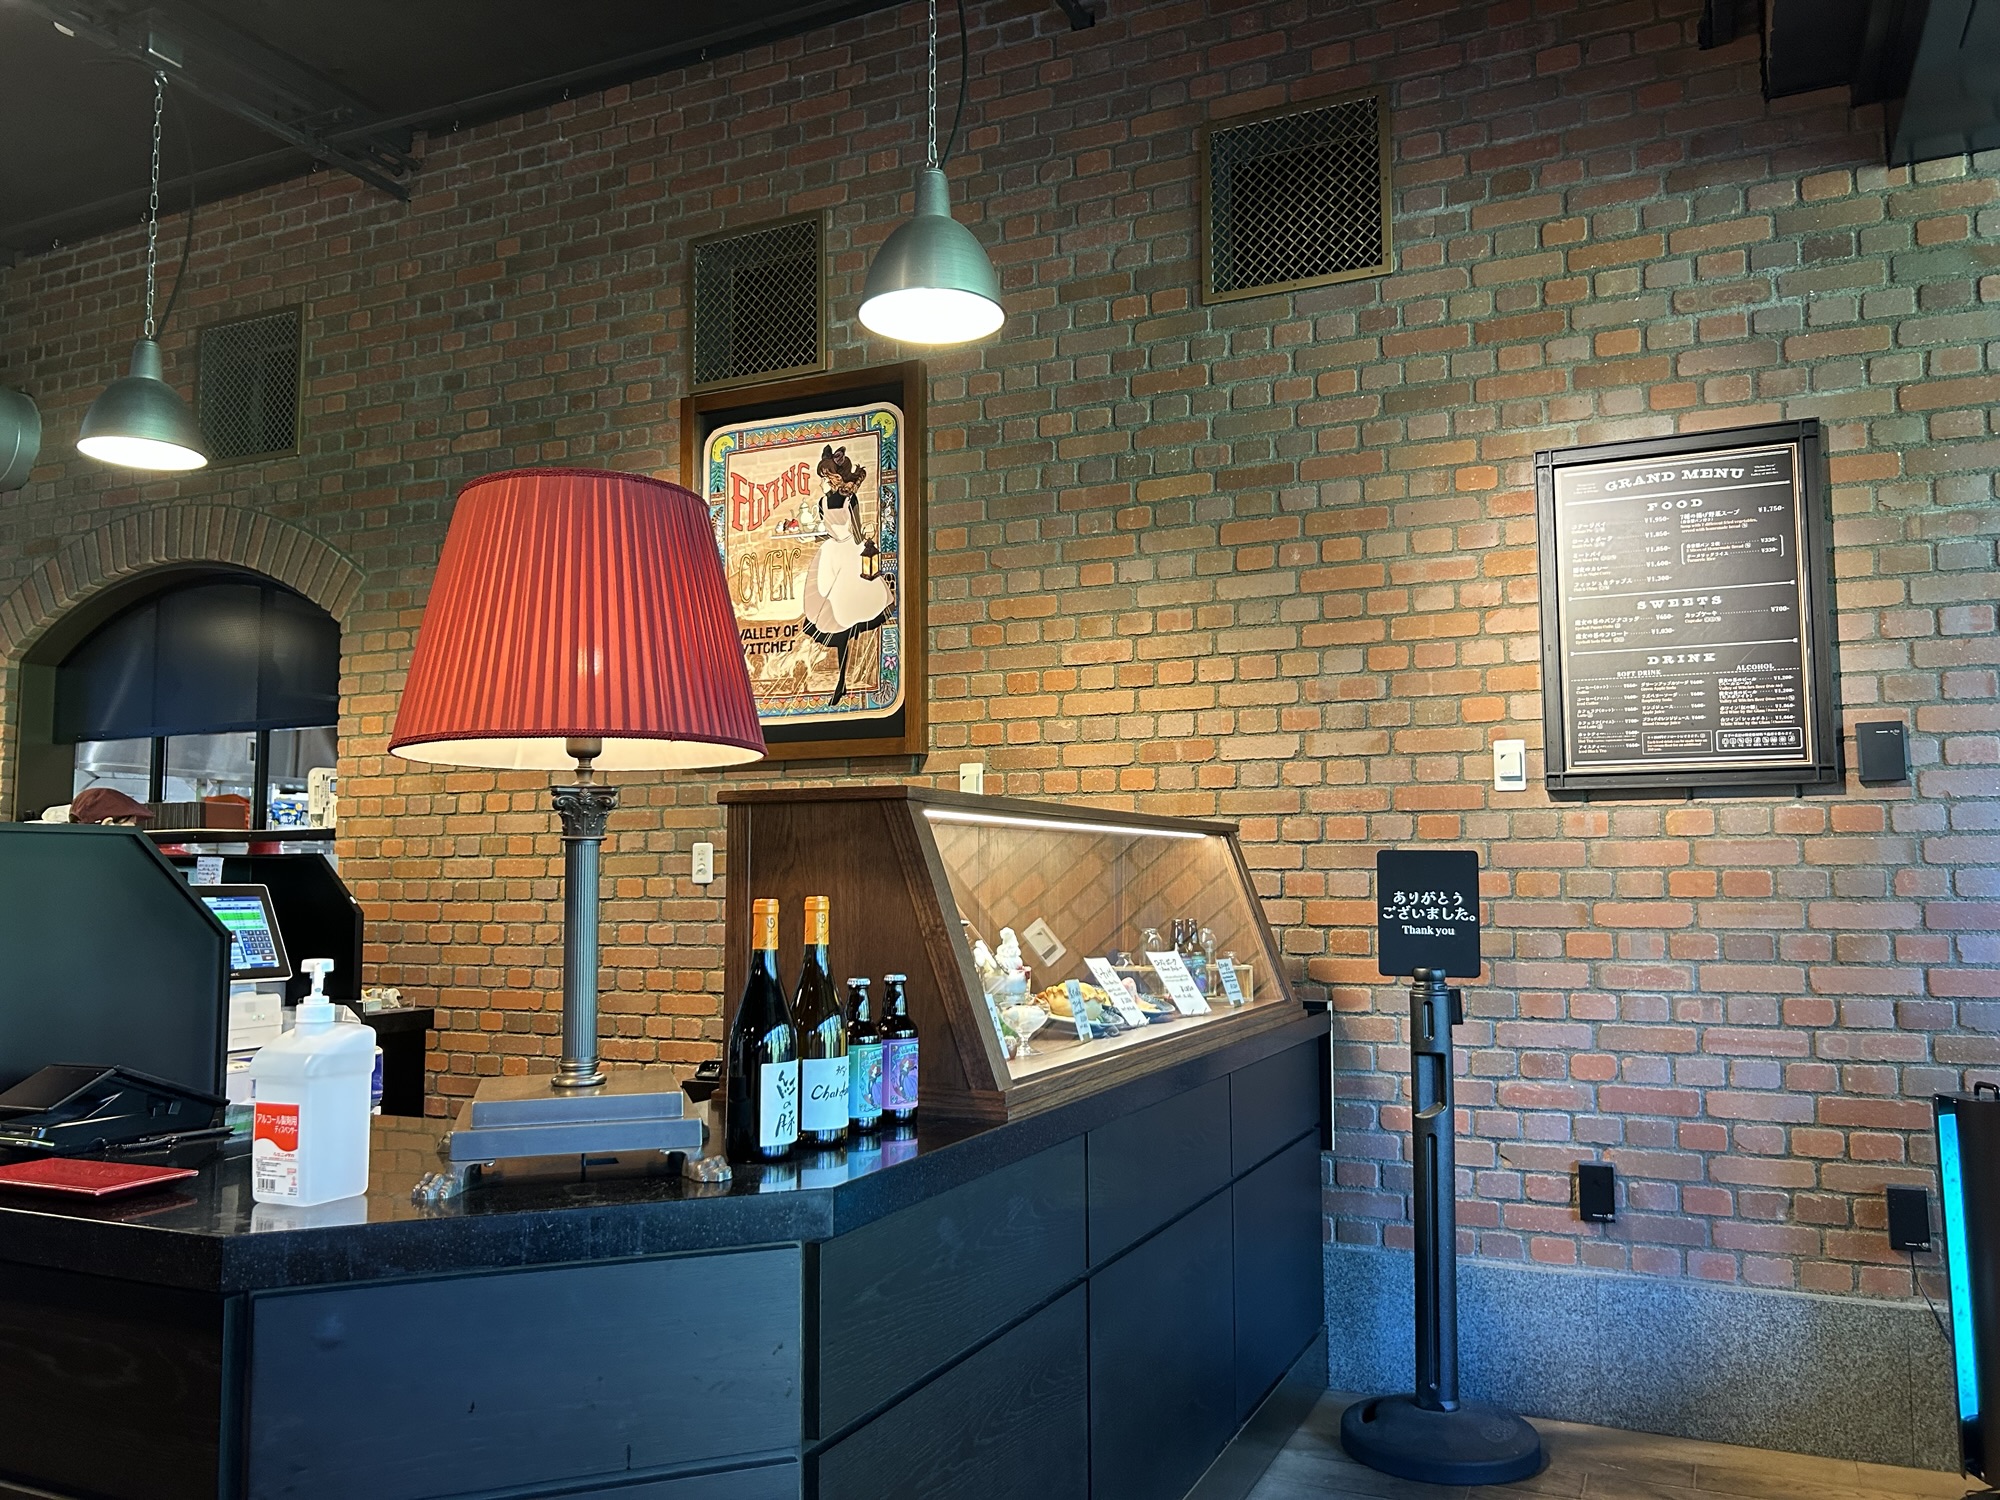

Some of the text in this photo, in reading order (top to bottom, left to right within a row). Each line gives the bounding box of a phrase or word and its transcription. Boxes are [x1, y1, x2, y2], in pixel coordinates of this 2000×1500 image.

[1605, 471, 1676, 491] GRAND
[1681, 468, 1745, 480] MENU
[730, 462, 811, 532] FLYING
[1646, 498, 1703, 512] FOOD
[738, 547, 803, 604] OVEN
[1636, 596, 1723, 610] SWEETS
[783, 624, 799, 638] OF
[1646, 652, 1716, 665] DRINK
[1616, 669, 1661, 678] SOFT DRINK
[1736, 663, 1775, 671] ALCOHOL
[1392, 890, 1464, 906] ありがとう
[1382, 905, 1477, 922] ございました。
[1401, 925, 1456, 937] Thank you
[256, 1113, 298, 1126] アルコール製剤用
